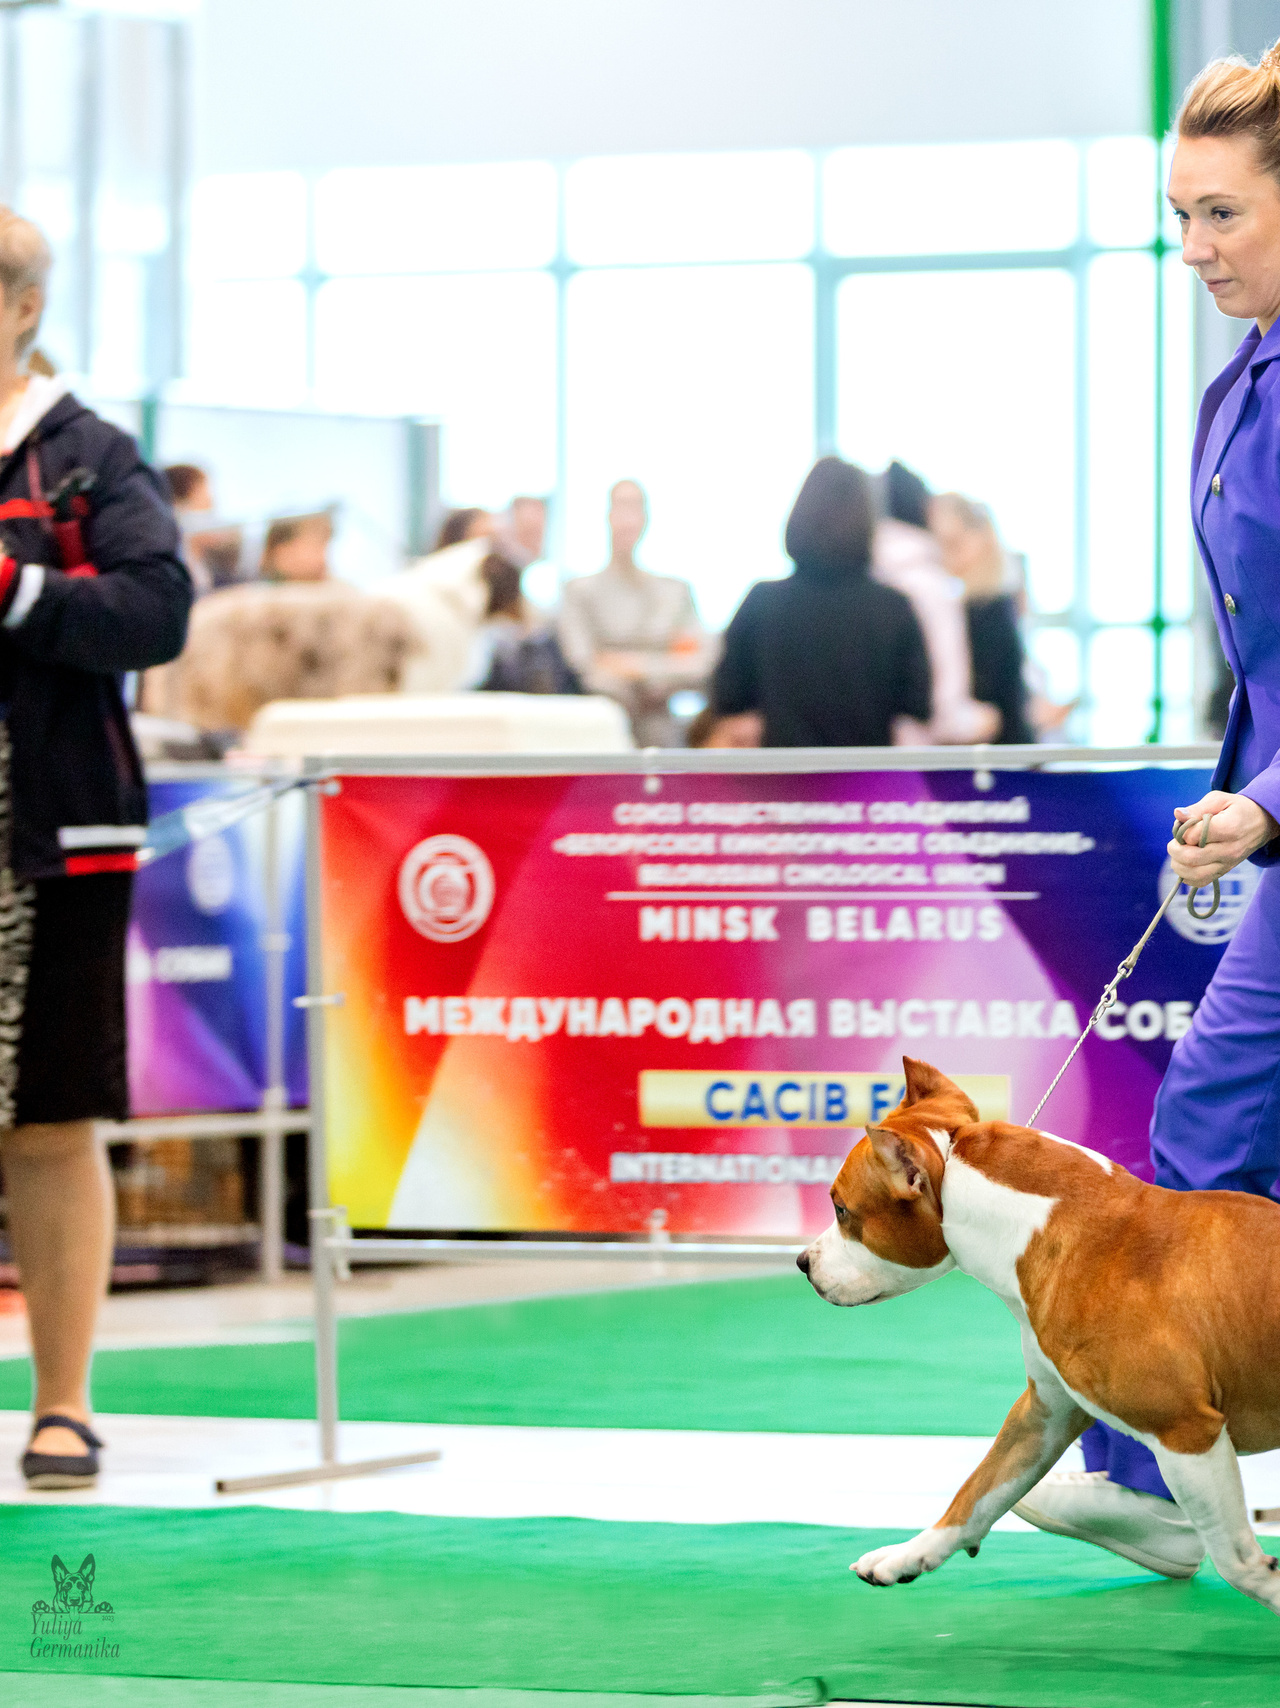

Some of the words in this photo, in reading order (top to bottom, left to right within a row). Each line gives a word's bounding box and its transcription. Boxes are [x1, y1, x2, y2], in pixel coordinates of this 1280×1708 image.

[639, 907, 779, 941] MINSK
[805, 906, 1003, 942] BELARUS
[404, 996, 818, 1044] МЕЖДУНАРОДНАЯ
[828, 998, 1081, 1039] ВЫСТАВКА
[705, 1081, 849, 1123] CACIB
